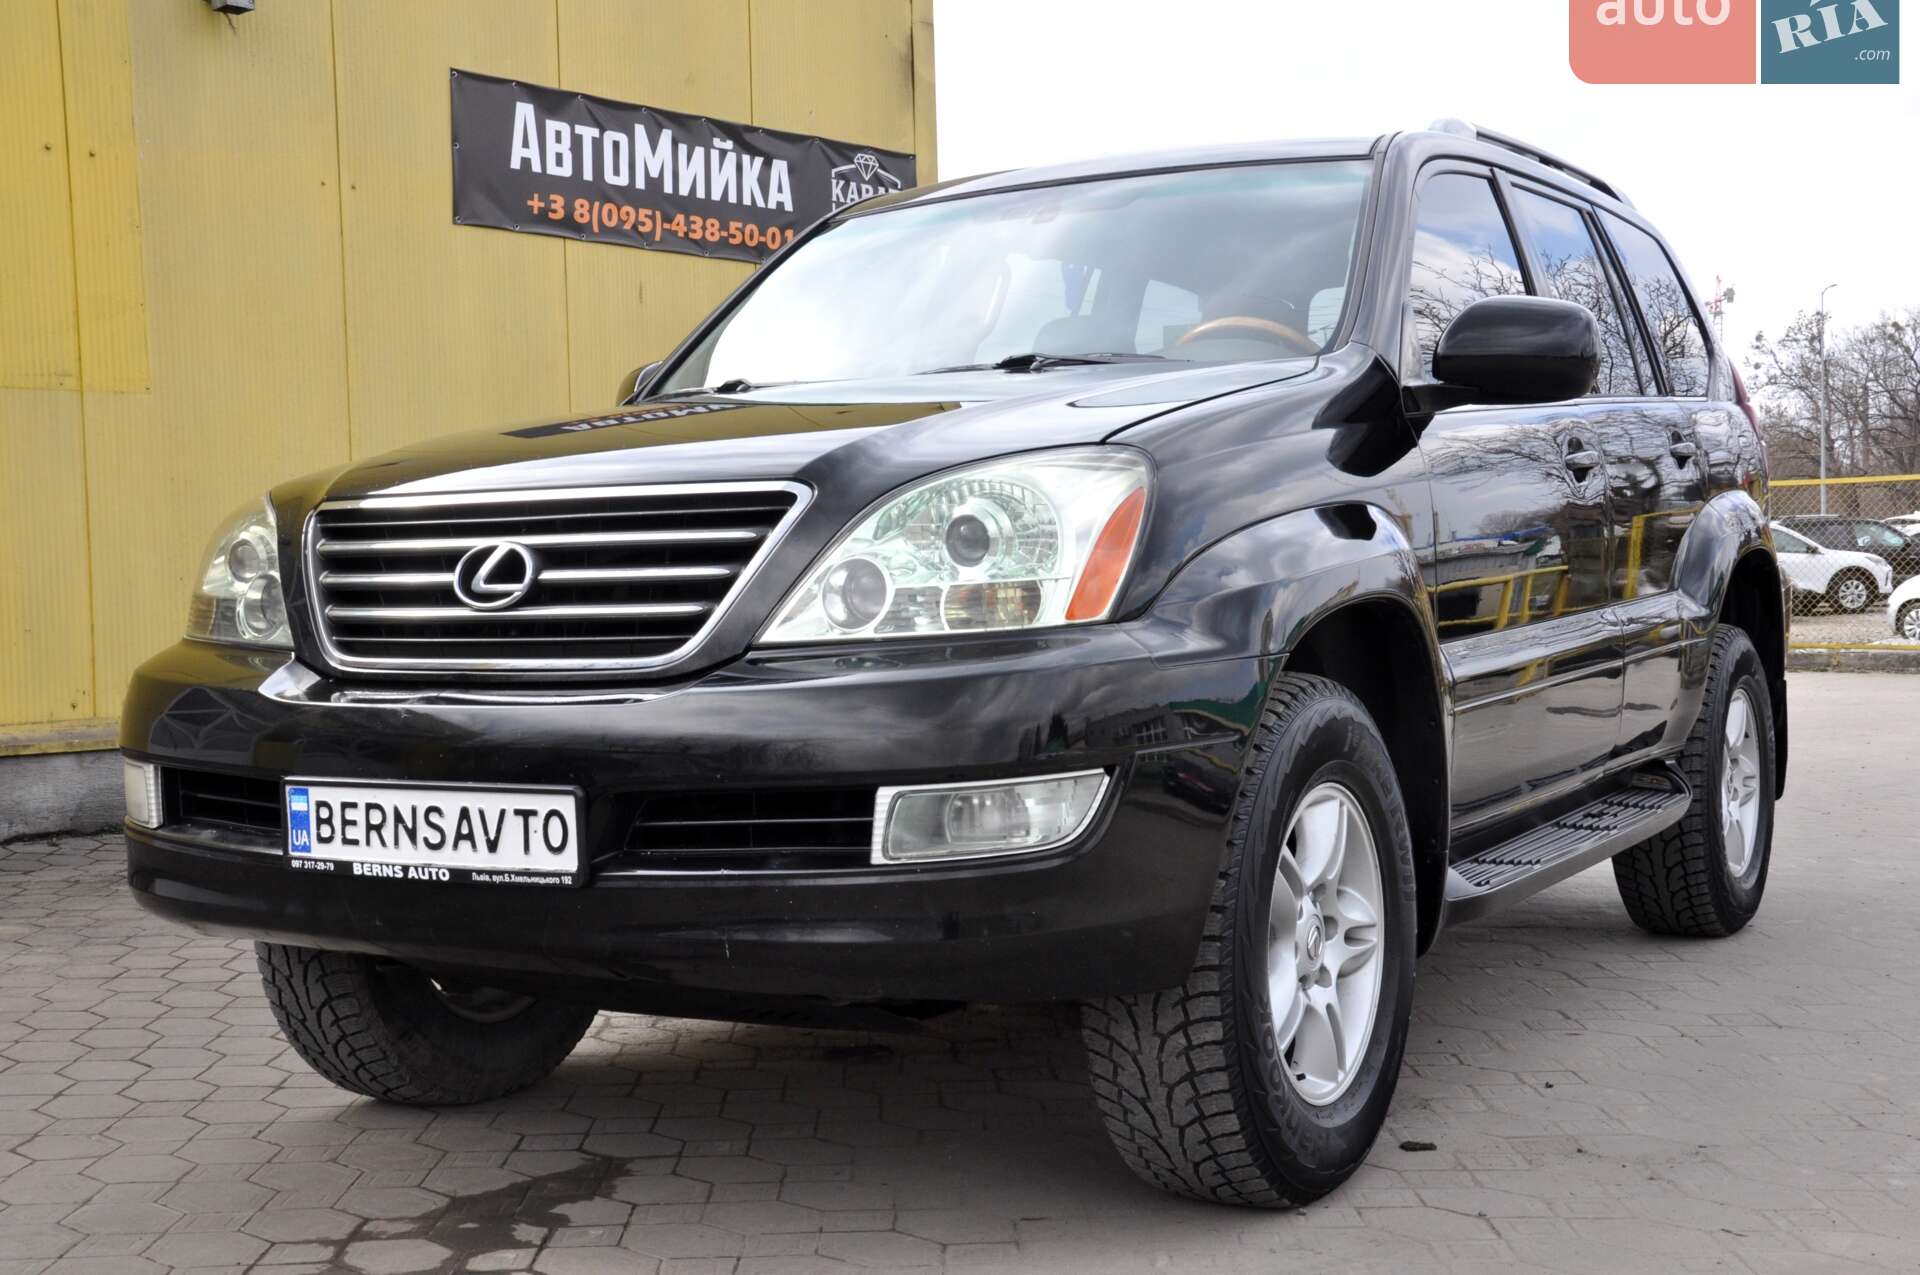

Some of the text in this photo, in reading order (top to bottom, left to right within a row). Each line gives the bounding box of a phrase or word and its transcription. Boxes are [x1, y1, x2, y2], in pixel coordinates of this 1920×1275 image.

[831, 178, 900, 204] КАР
[527, 193, 565, 220] +3
[292, 829, 309, 846] UA
[314, 799, 569, 856] BERNSAVTO
[291, 859, 302, 868] 097
[352, 862, 451, 882] BERNS AUTO
[561, 875, 573, 884] 192
